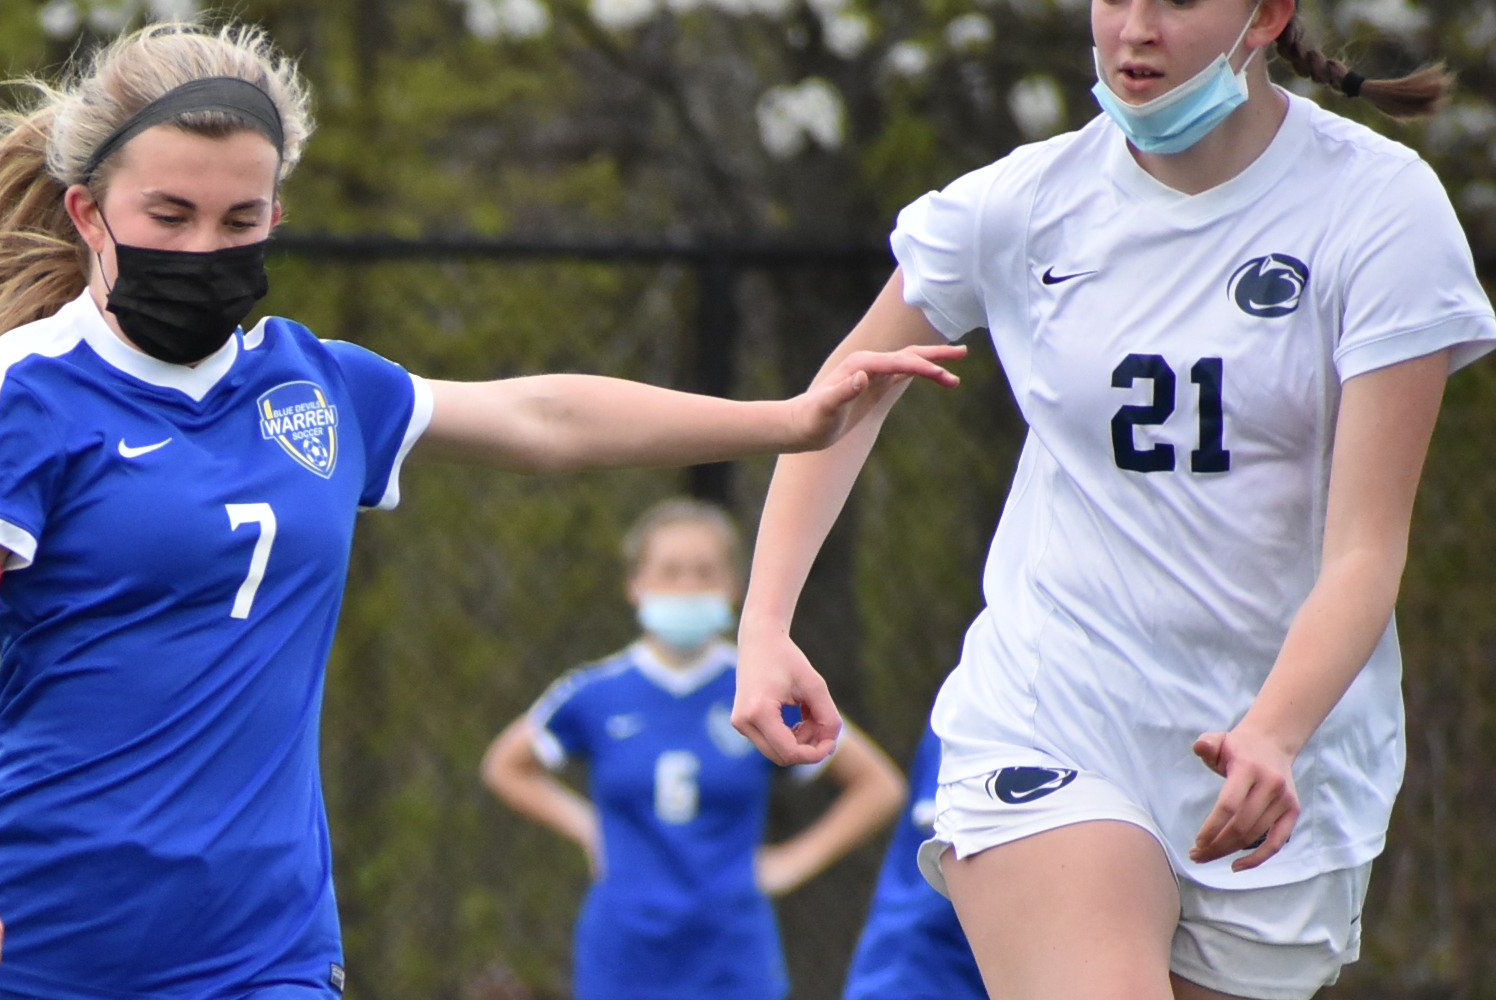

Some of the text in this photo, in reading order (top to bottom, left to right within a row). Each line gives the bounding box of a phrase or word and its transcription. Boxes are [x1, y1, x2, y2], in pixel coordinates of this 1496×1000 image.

[265, 407, 335, 435] WARREN
[273, 401, 321, 417] BLUE DEVILS
[292, 427, 323, 440] SOCCER
[1111, 353, 1230, 473] 21
[225, 503, 276, 619] 7
[656, 750, 700, 825] 6
